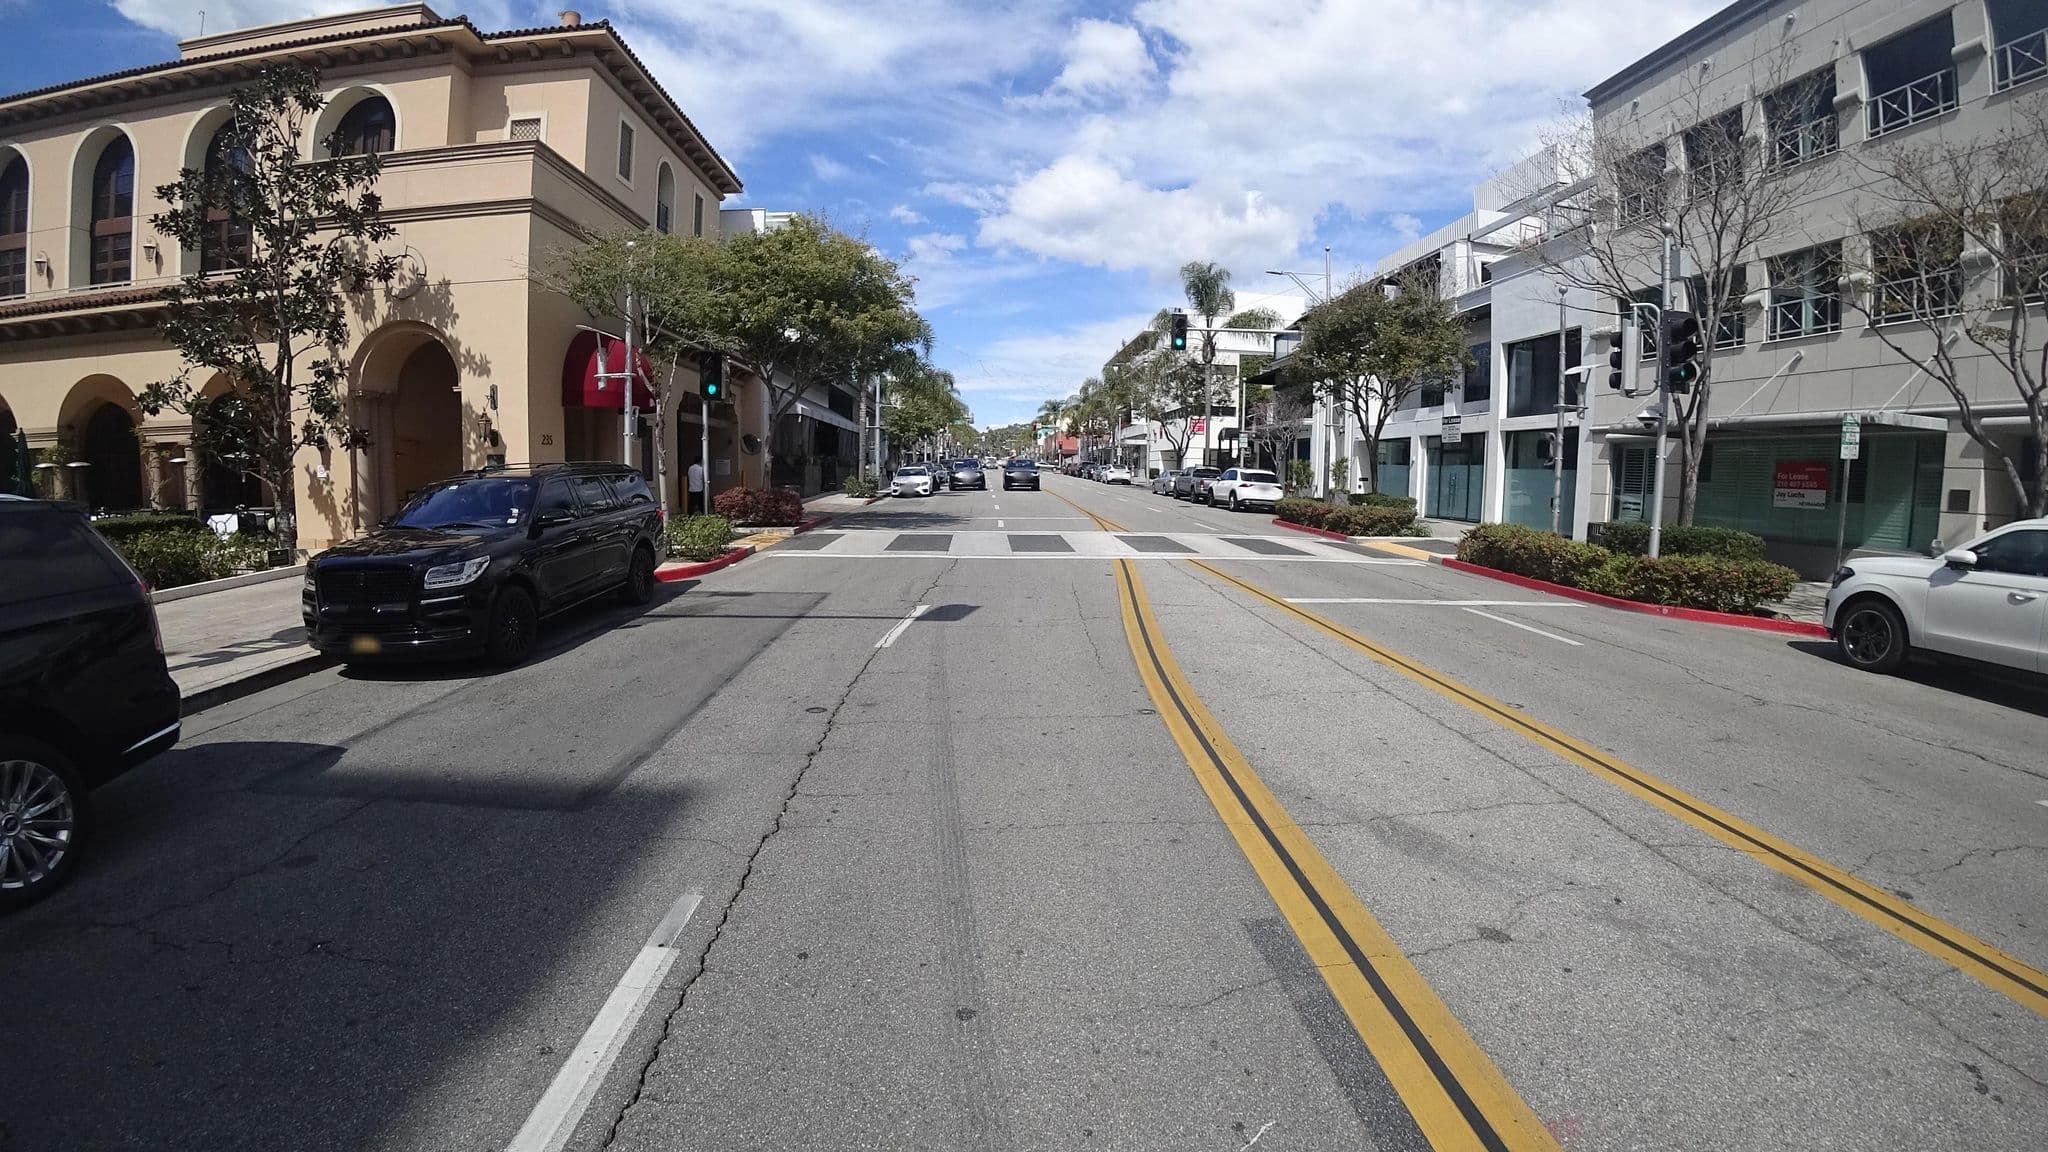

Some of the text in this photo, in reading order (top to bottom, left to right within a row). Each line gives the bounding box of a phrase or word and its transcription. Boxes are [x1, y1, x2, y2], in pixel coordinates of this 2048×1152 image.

[541, 434, 553, 445] 235
[1777, 472, 1809, 480] For Lease
